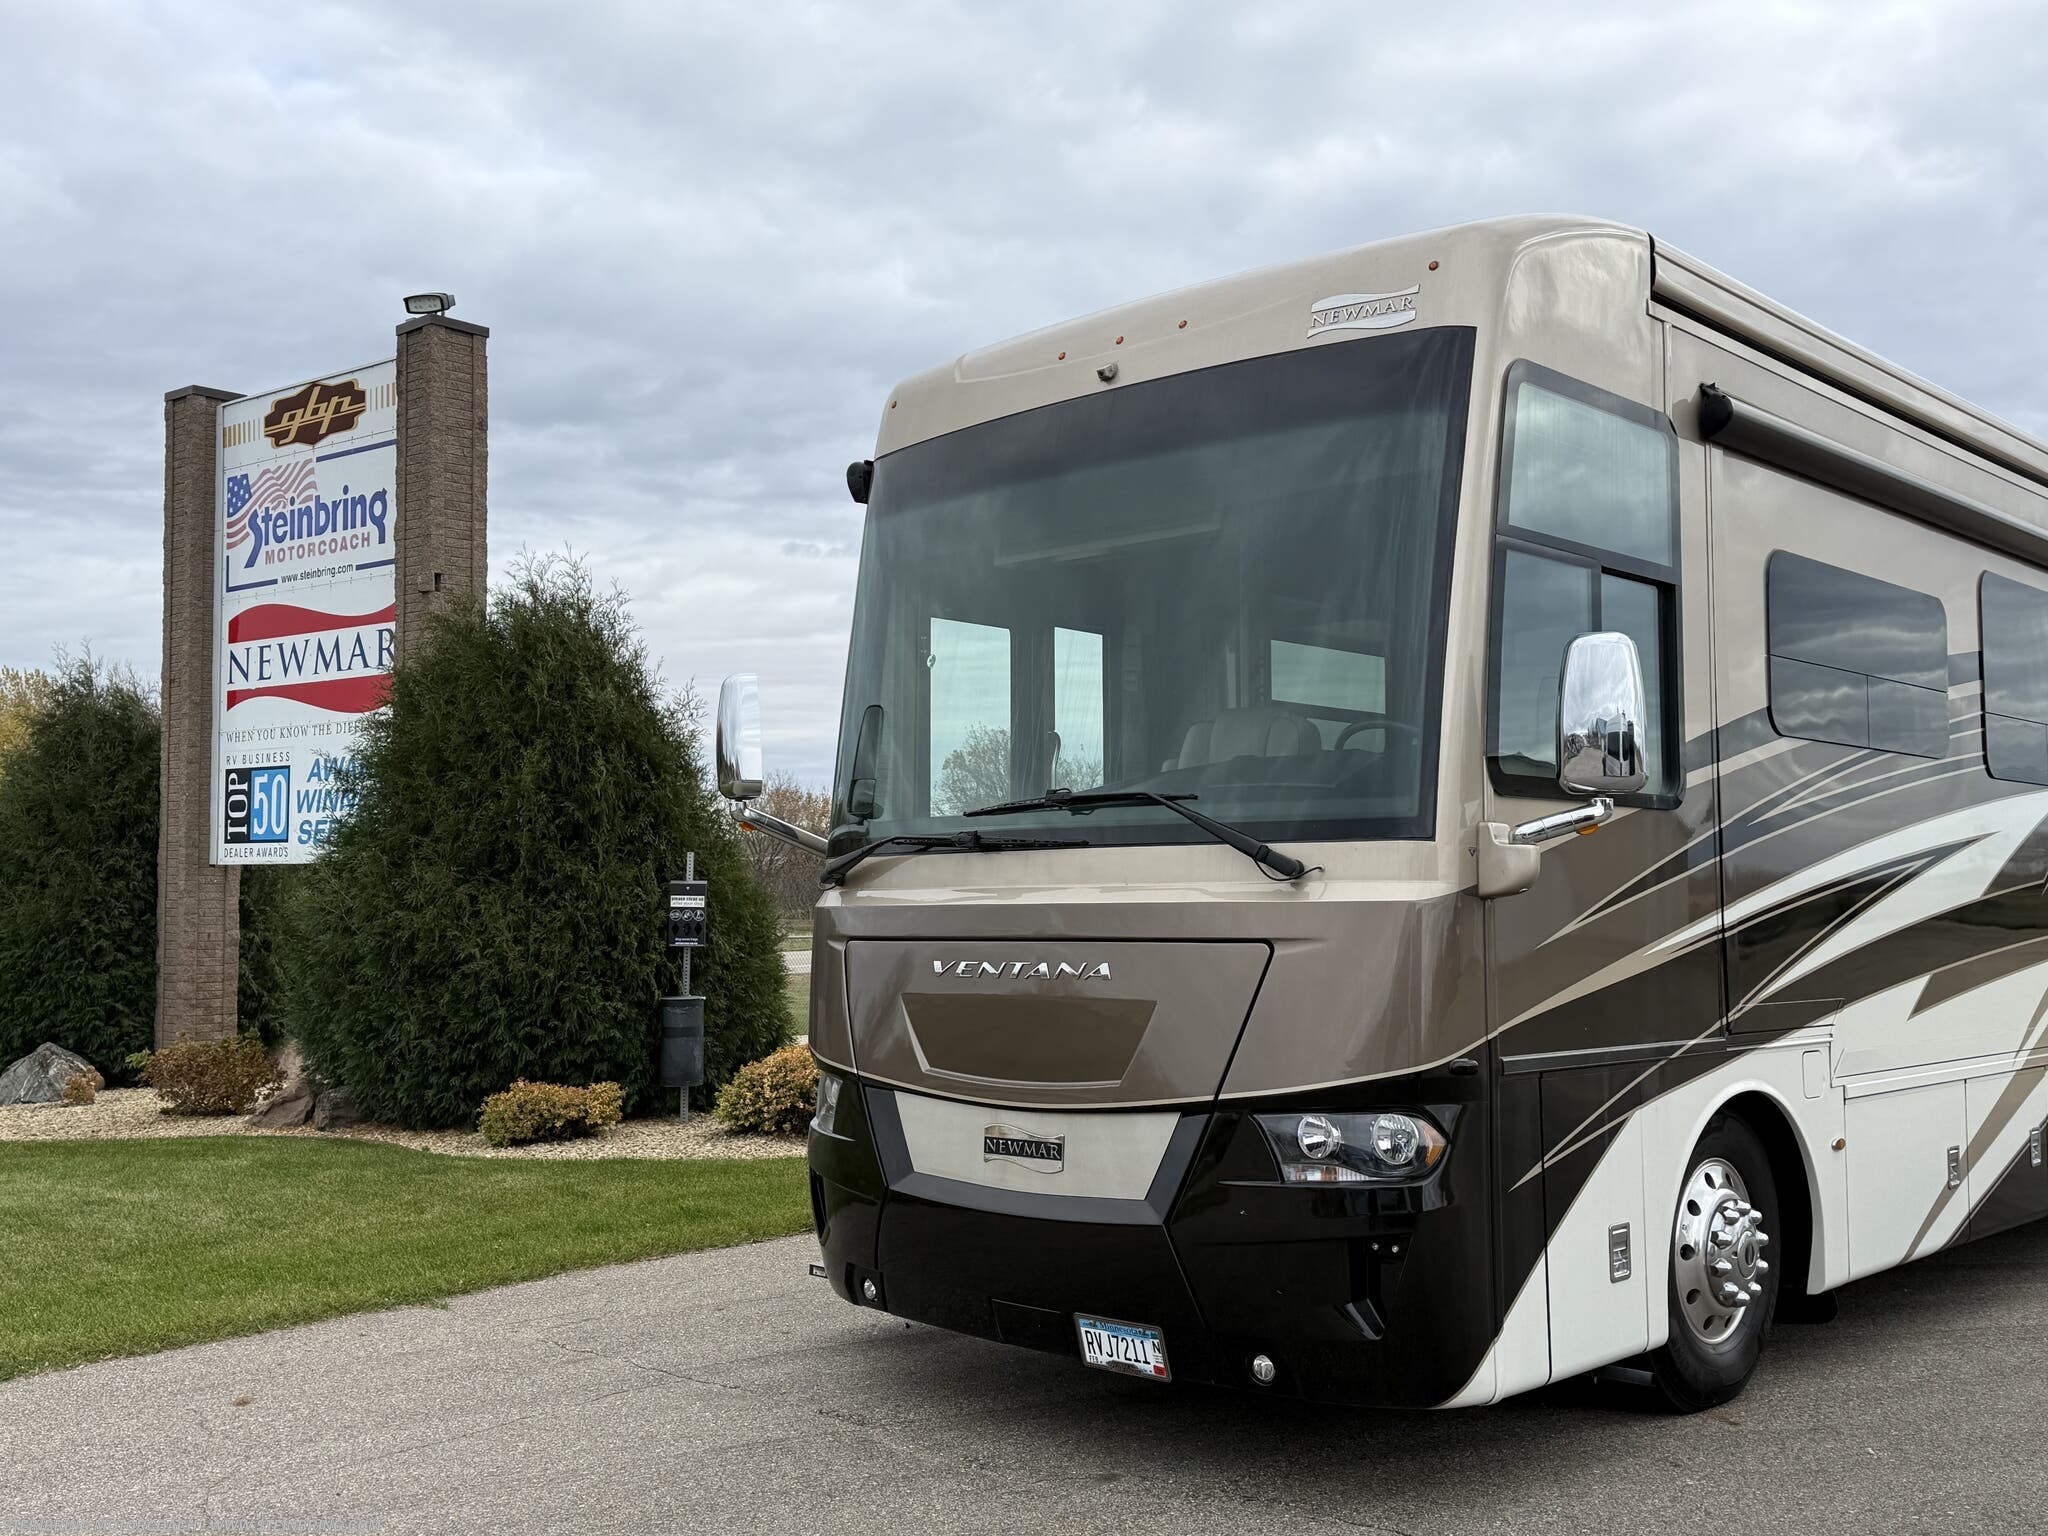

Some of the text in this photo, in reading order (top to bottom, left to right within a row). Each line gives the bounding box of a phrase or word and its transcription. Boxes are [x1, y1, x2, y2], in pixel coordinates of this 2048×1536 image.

[1311, 296, 1416, 328] NEWMAR
[244, 484, 387, 569] Steinbring
[265, 531, 371, 566] MOTORCOACH
[281, 562, 354, 584] www.steinbring.com
[227, 628, 394, 685] NEWMAR
[226, 730, 254, 744] WHEN
[256, 727, 276, 741] YOU
[280, 725, 309, 739] KNOW
[312, 723, 332, 736] THE
[226, 751, 290, 766] RV BUSINESS
[227, 772, 287, 840] TOP 50
[224, 846, 289, 858] DEALER AWARDS
[933, 960, 1112, 980] VENTANA
[985, 1138, 1061, 1160] NEWMAR
